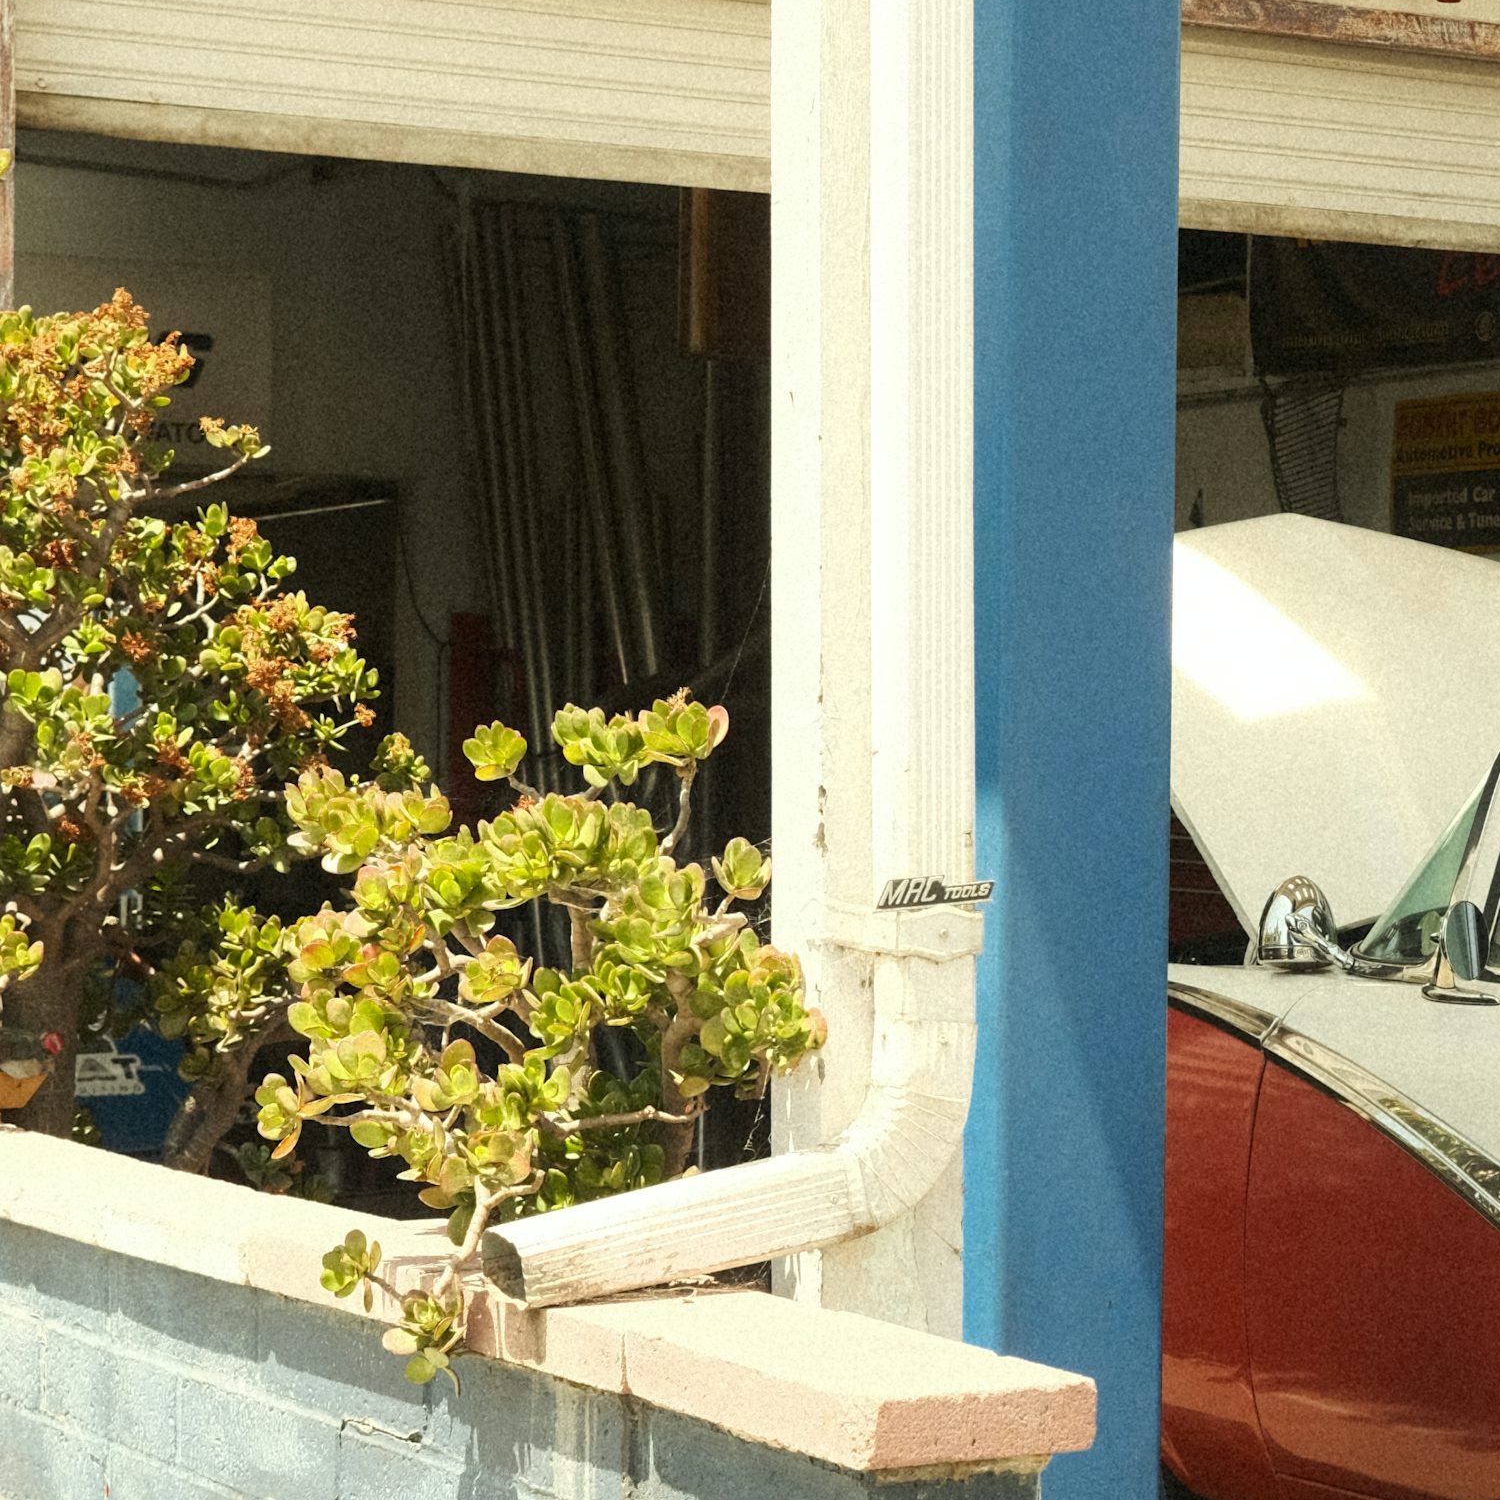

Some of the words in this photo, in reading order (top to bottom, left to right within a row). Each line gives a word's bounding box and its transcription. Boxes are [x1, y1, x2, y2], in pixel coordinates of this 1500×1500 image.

[1407, 486, 1469, 511] Imported
[1472, 485, 1496, 503] Car
[1456, 513, 1466, 531] &
[878, 875, 944, 907] MAC
[944, 883, 992, 901] TOOLS
